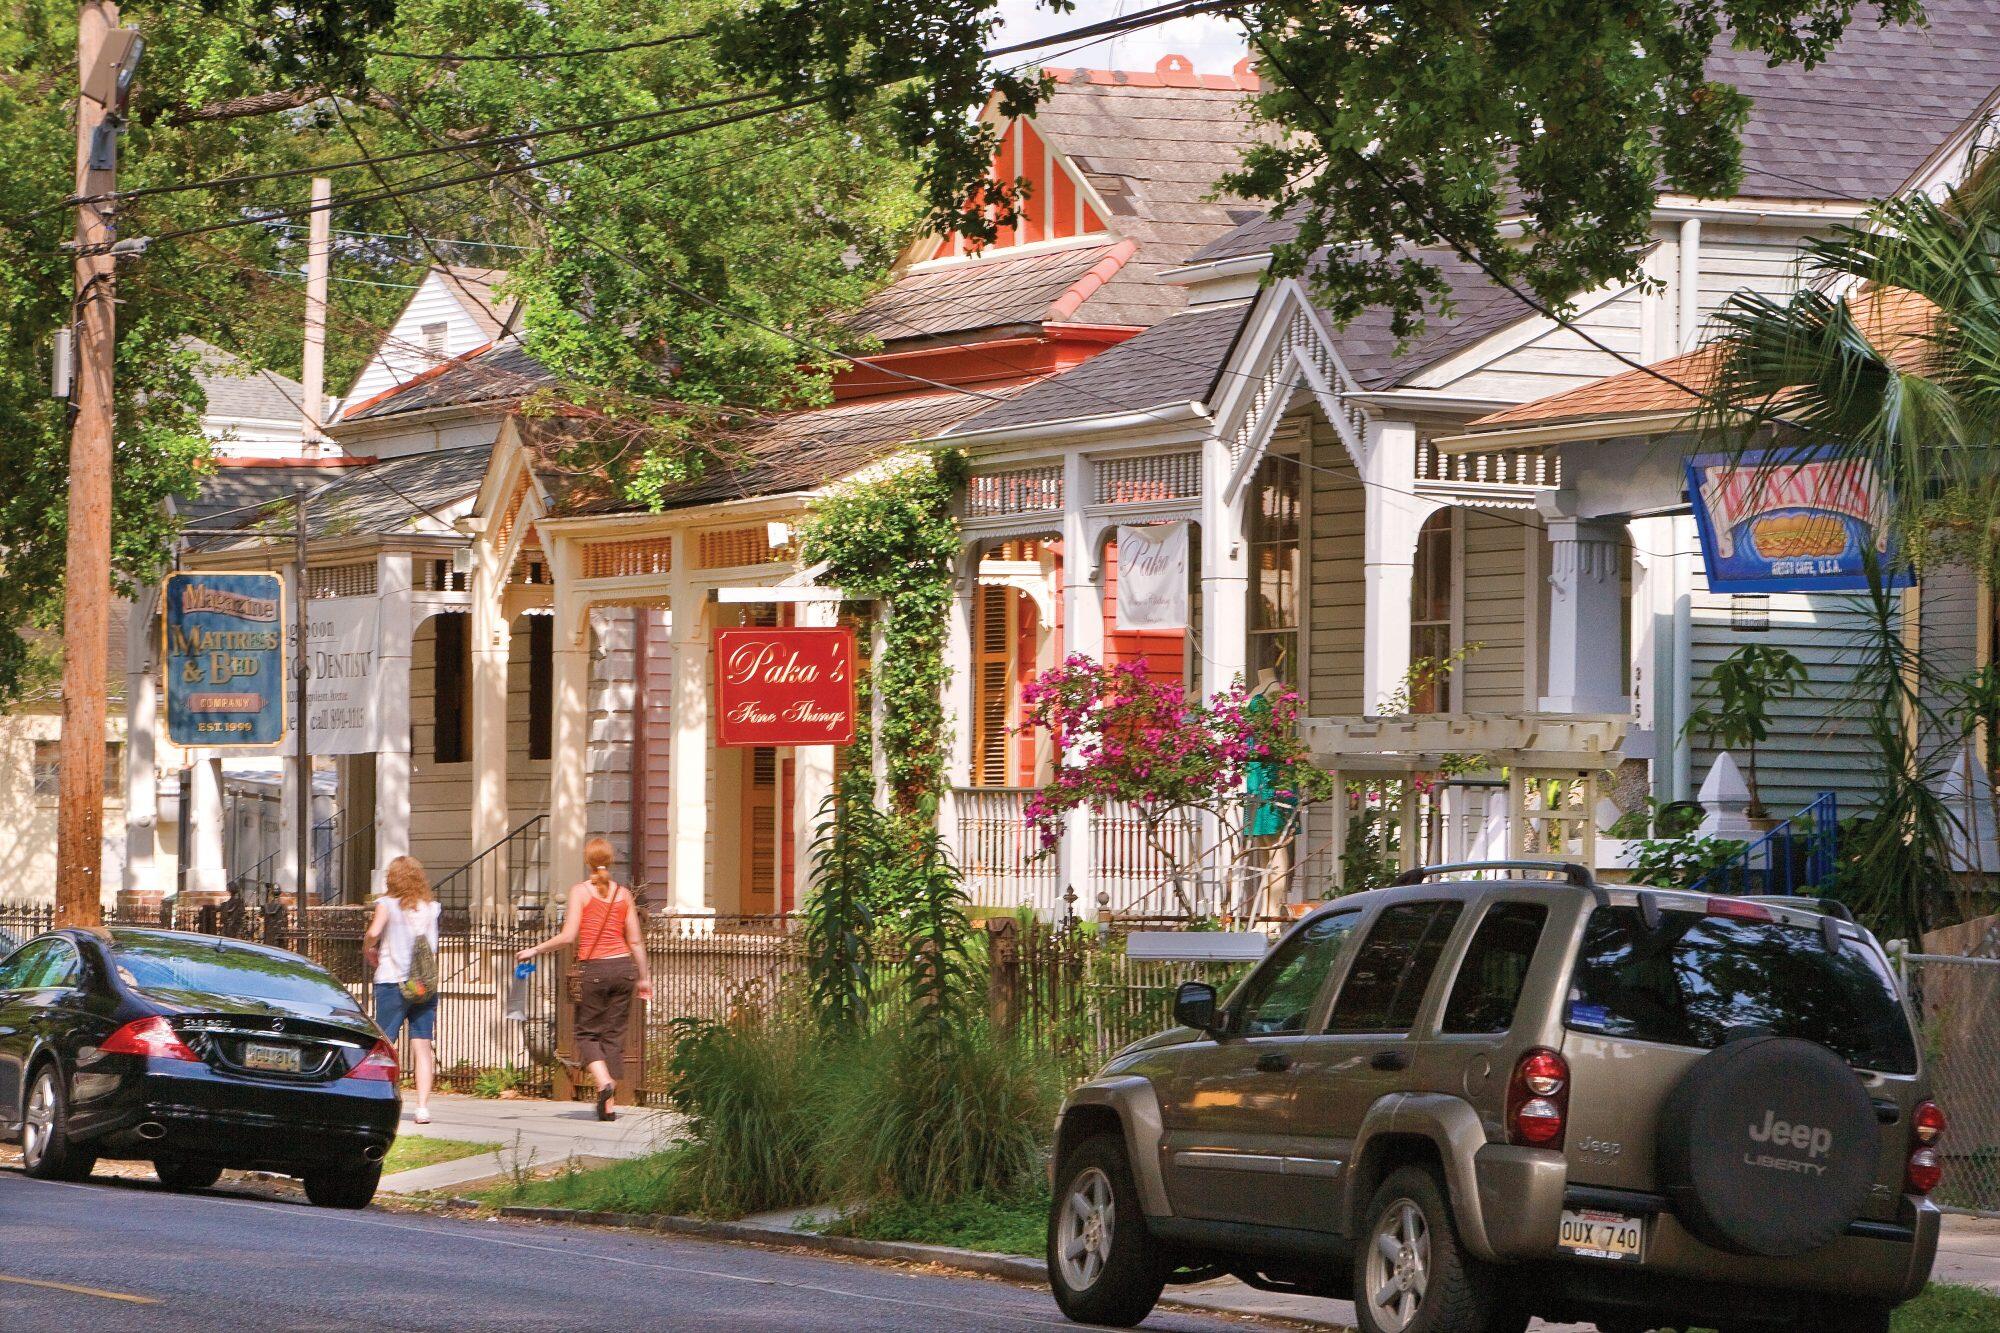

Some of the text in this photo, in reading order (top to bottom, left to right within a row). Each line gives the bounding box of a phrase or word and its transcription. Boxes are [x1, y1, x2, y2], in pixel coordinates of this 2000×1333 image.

[185, 584, 274, 618] Magazine
[183, 659, 206, 683] &
[199, 698, 250, 708] COMPANY
[727, 699, 846, 731] Fine Things
[224, 722, 253, 732] 1999
[1579, 1136, 1621, 1155] Jeep
[1748, 1110, 1832, 1158] Jeep
[1744, 1153, 1827, 1176] LIBERTY
[1563, 1221, 1637, 1249] OUX 740
